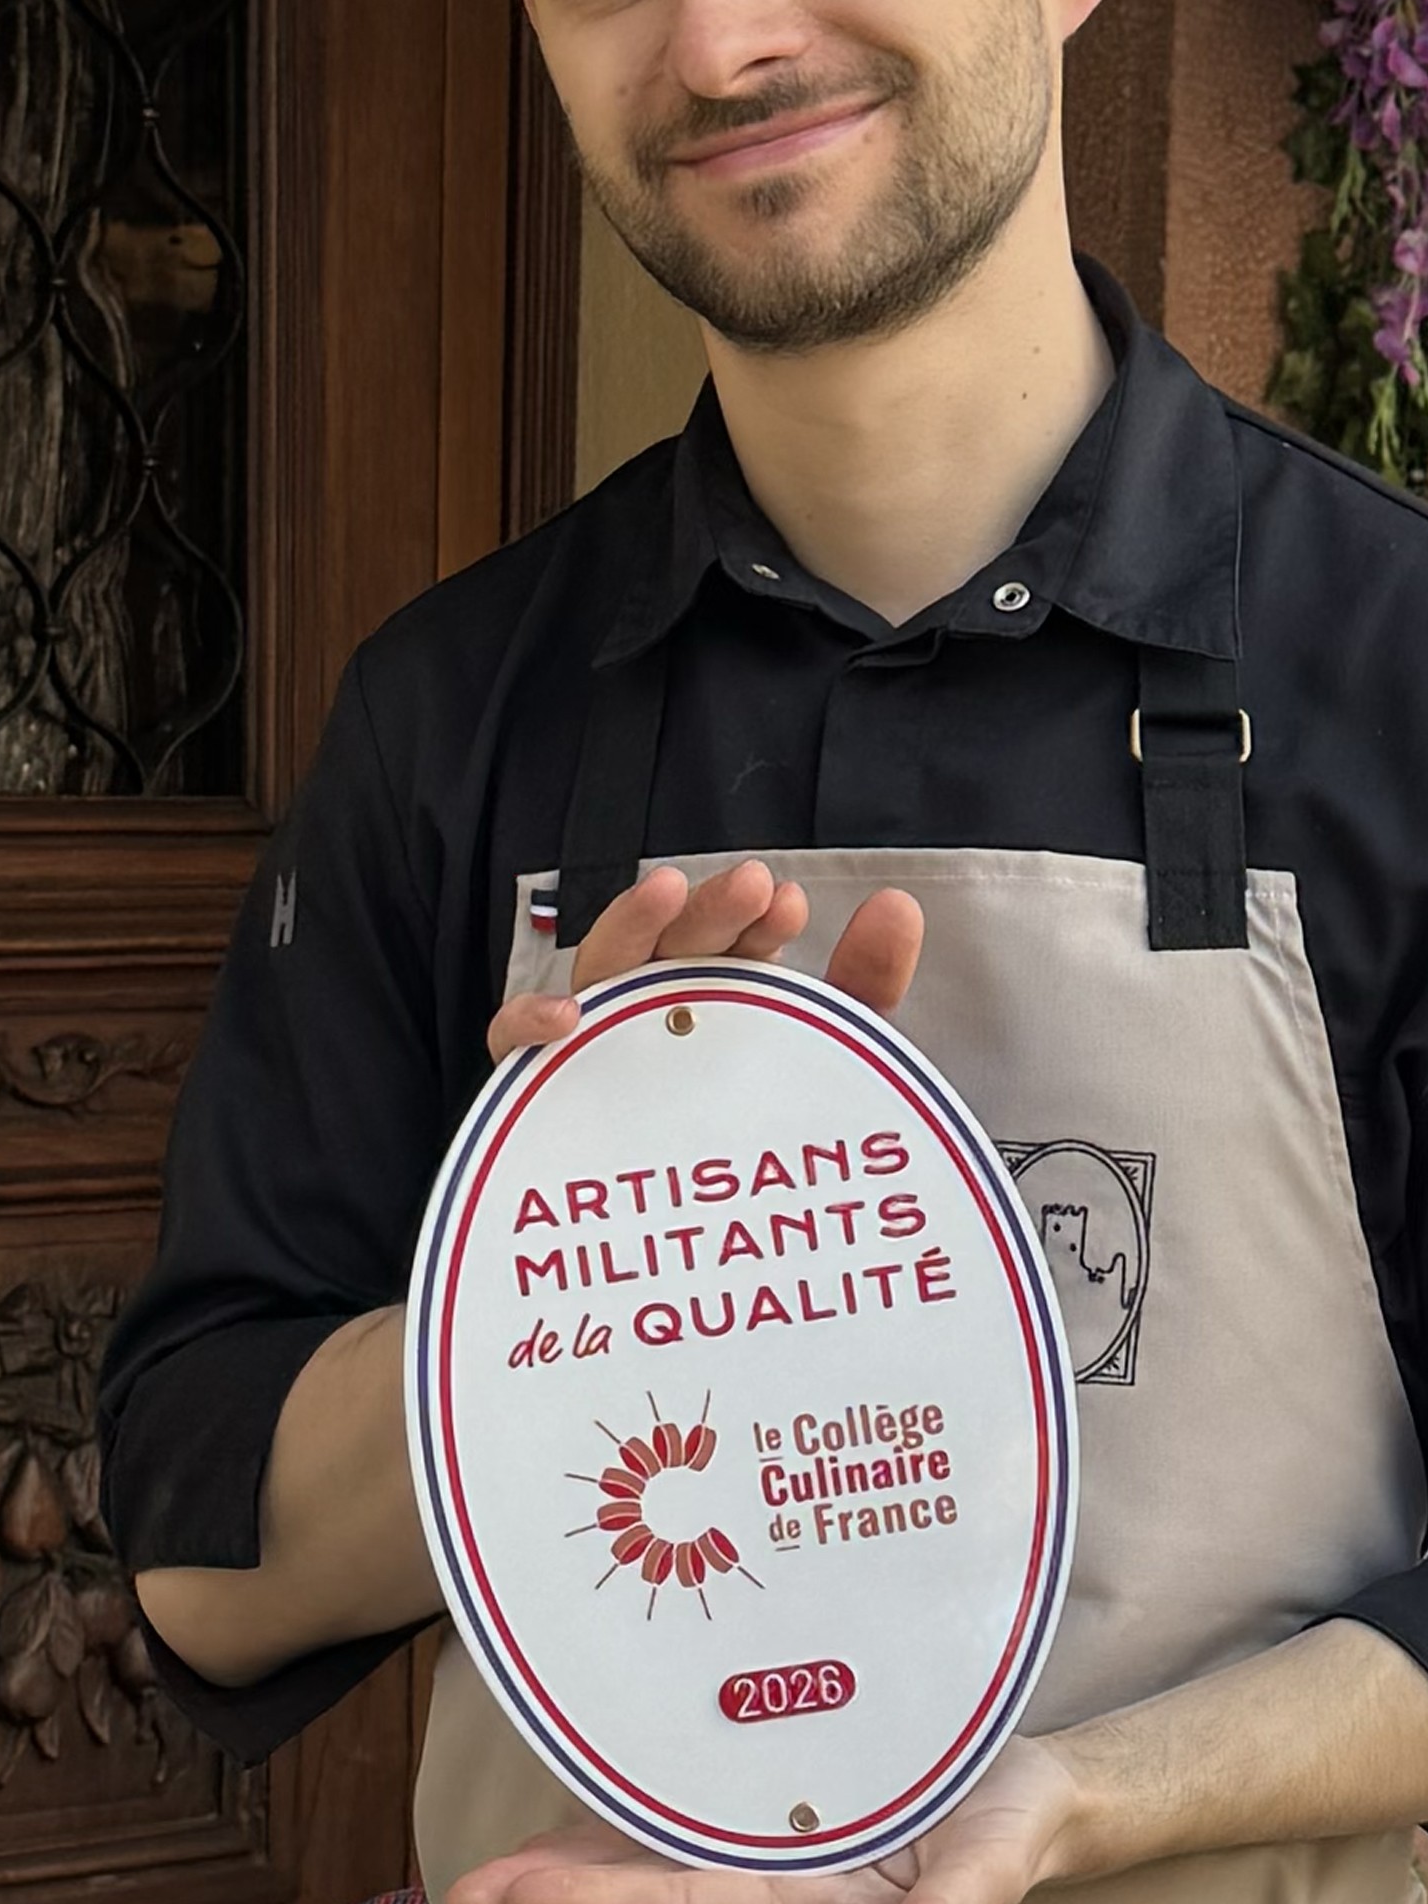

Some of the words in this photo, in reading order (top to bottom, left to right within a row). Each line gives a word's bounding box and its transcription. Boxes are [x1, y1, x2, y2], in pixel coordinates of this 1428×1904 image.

[513, 1131, 910, 1234] ARTISANS
[514, 1193, 926, 1297] MILITANTS
[507, 1318, 563, 1369] de
[571, 1313, 612, 1359] la
[632, 1246, 957, 1346] QUALITÉ
[753, 1421, 782, 1453] le
[792, 1403, 945, 1456] Collège
[761, 1445, 952, 1507] Culinaire
[769, 1513, 801, 1543] de
[813, 1494, 959, 1546] France
[733, 1664, 844, 1718] 2026
